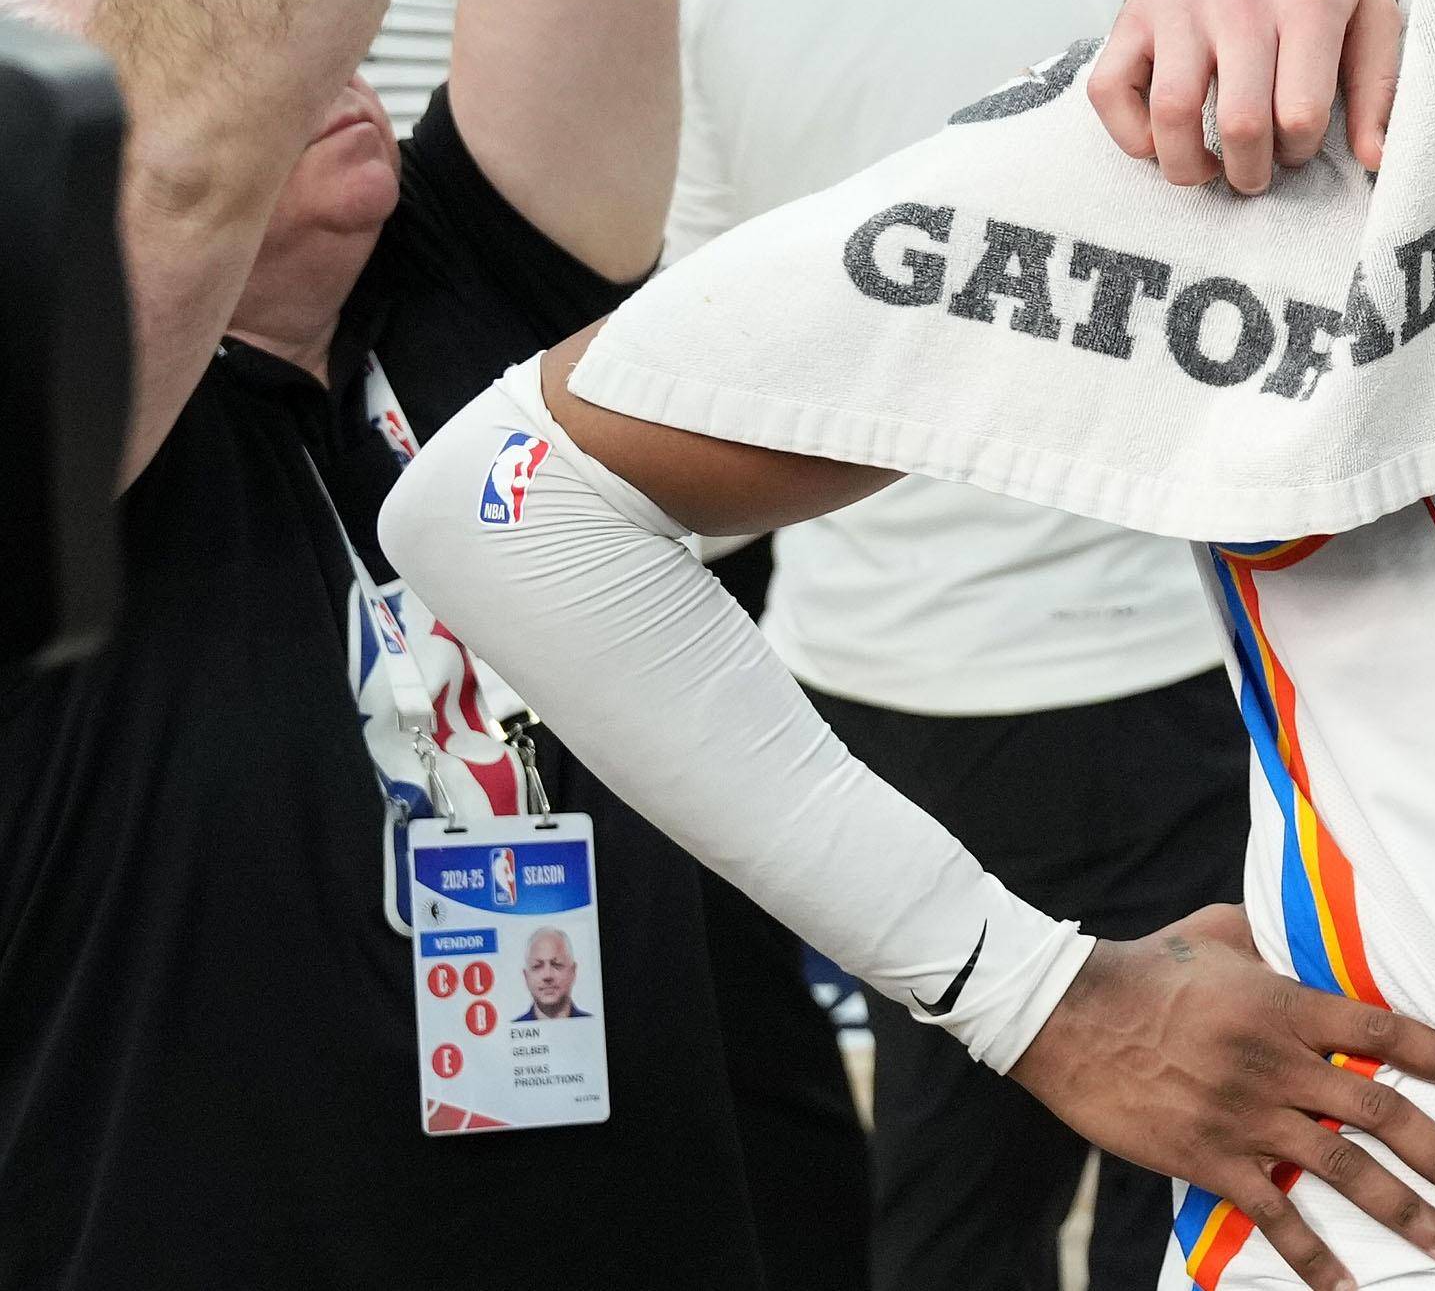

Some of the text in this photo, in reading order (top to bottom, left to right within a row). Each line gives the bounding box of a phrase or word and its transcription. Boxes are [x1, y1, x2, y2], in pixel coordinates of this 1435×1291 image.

[484, 502, 506, 520] NBA
[441, 864, 566, 891] 2024-25 SEASON
[434, 935, 484, 950] VENDOR
[511, 1028, 541, 1039] EVAN
[514, 1073, 585, 1089] PRODUCTIONS
